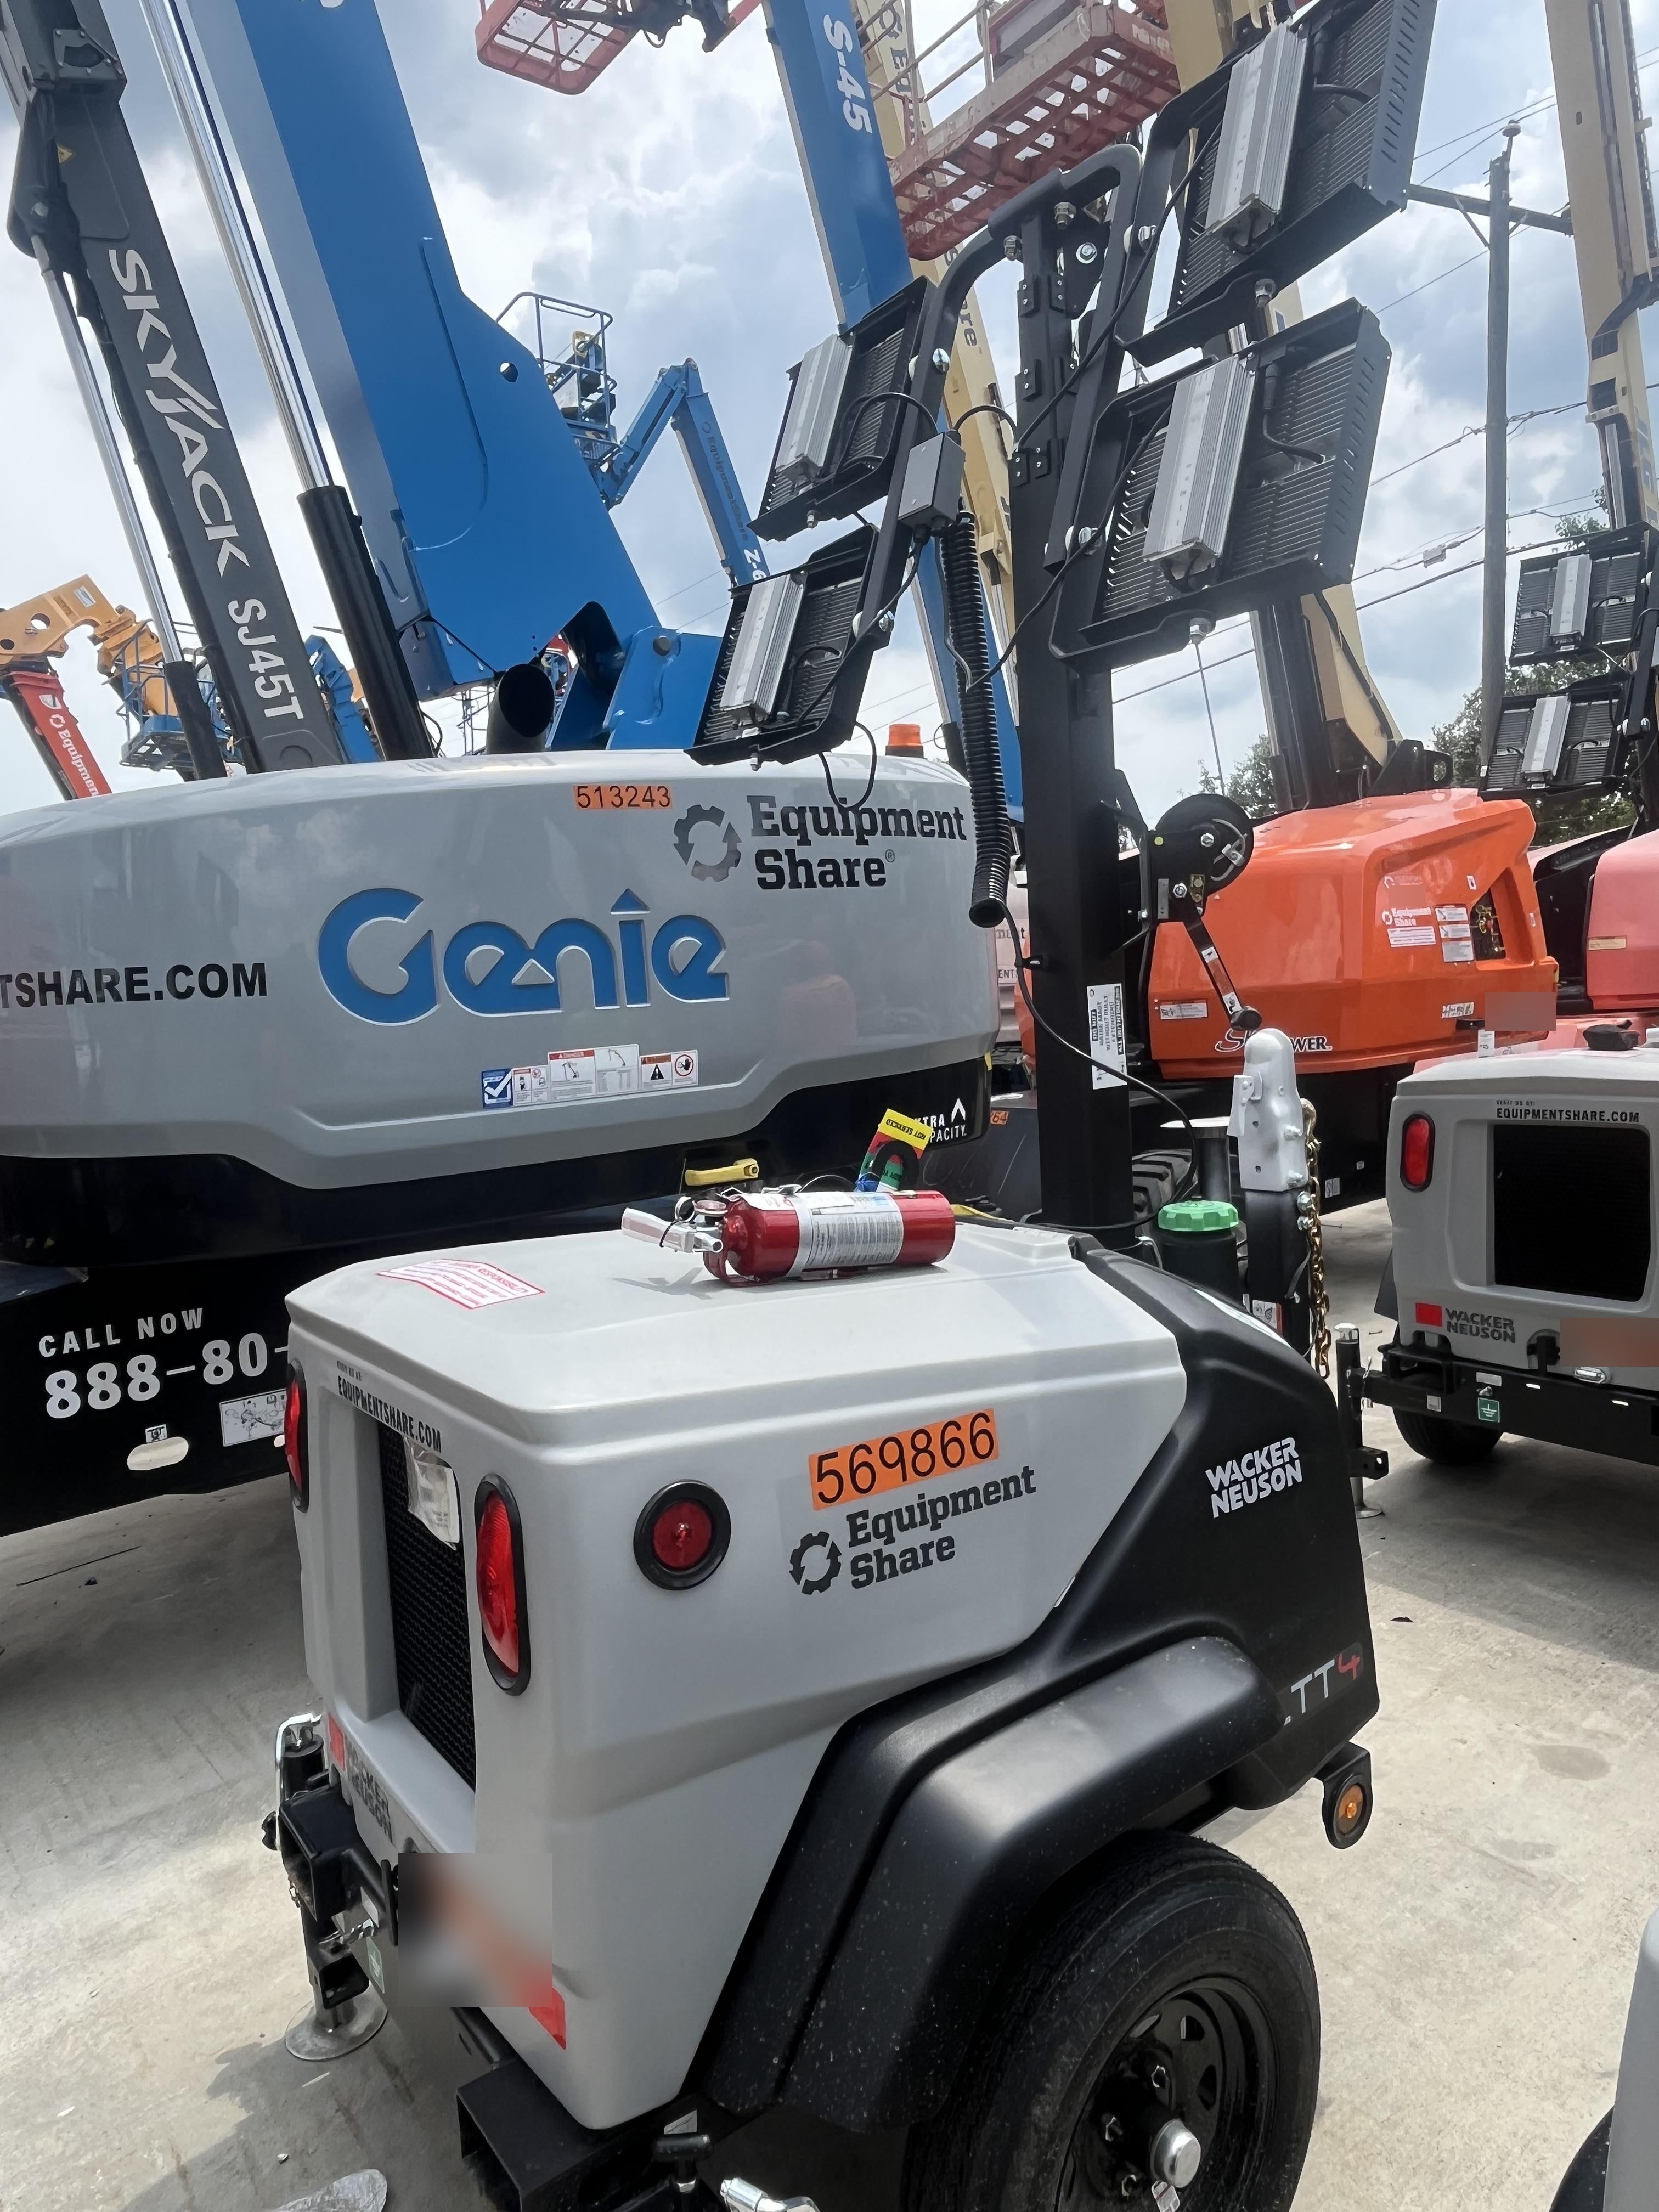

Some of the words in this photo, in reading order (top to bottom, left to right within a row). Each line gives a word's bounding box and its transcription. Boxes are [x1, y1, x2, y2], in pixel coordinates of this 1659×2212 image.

[823, 14, 872, 133] S-45
[111, 249, 251, 577] SKYJACK
[228, 597, 304, 721] SJ45T
[577, 785, 672, 809] 513243
[747, 795, 967, 847] Equipment
[318, 887, 730, 1026] Genie
[1496, 1108, 1640, 1123] EQUIPMENTSHARE.COM
[39, 1324, 121, 1358] CALL
[137, 1307, 203, 1340] NOW
[1445, 1308, 1515, 1331] WACKER
[1447, 1321, 1516, 1344] NEUSON
[338, 1375, 442, 1453] EQUIPMENTSHARE.COM
[816, 1412, 995, 1504] 569866
[1205, 1437, 1299, 1491] WACKER
[846, 1465, 1037, 1548] Equipment
[1210, 1459, 1303, 1519] NEUSON
[850, 1535, 956, 1589] Share
